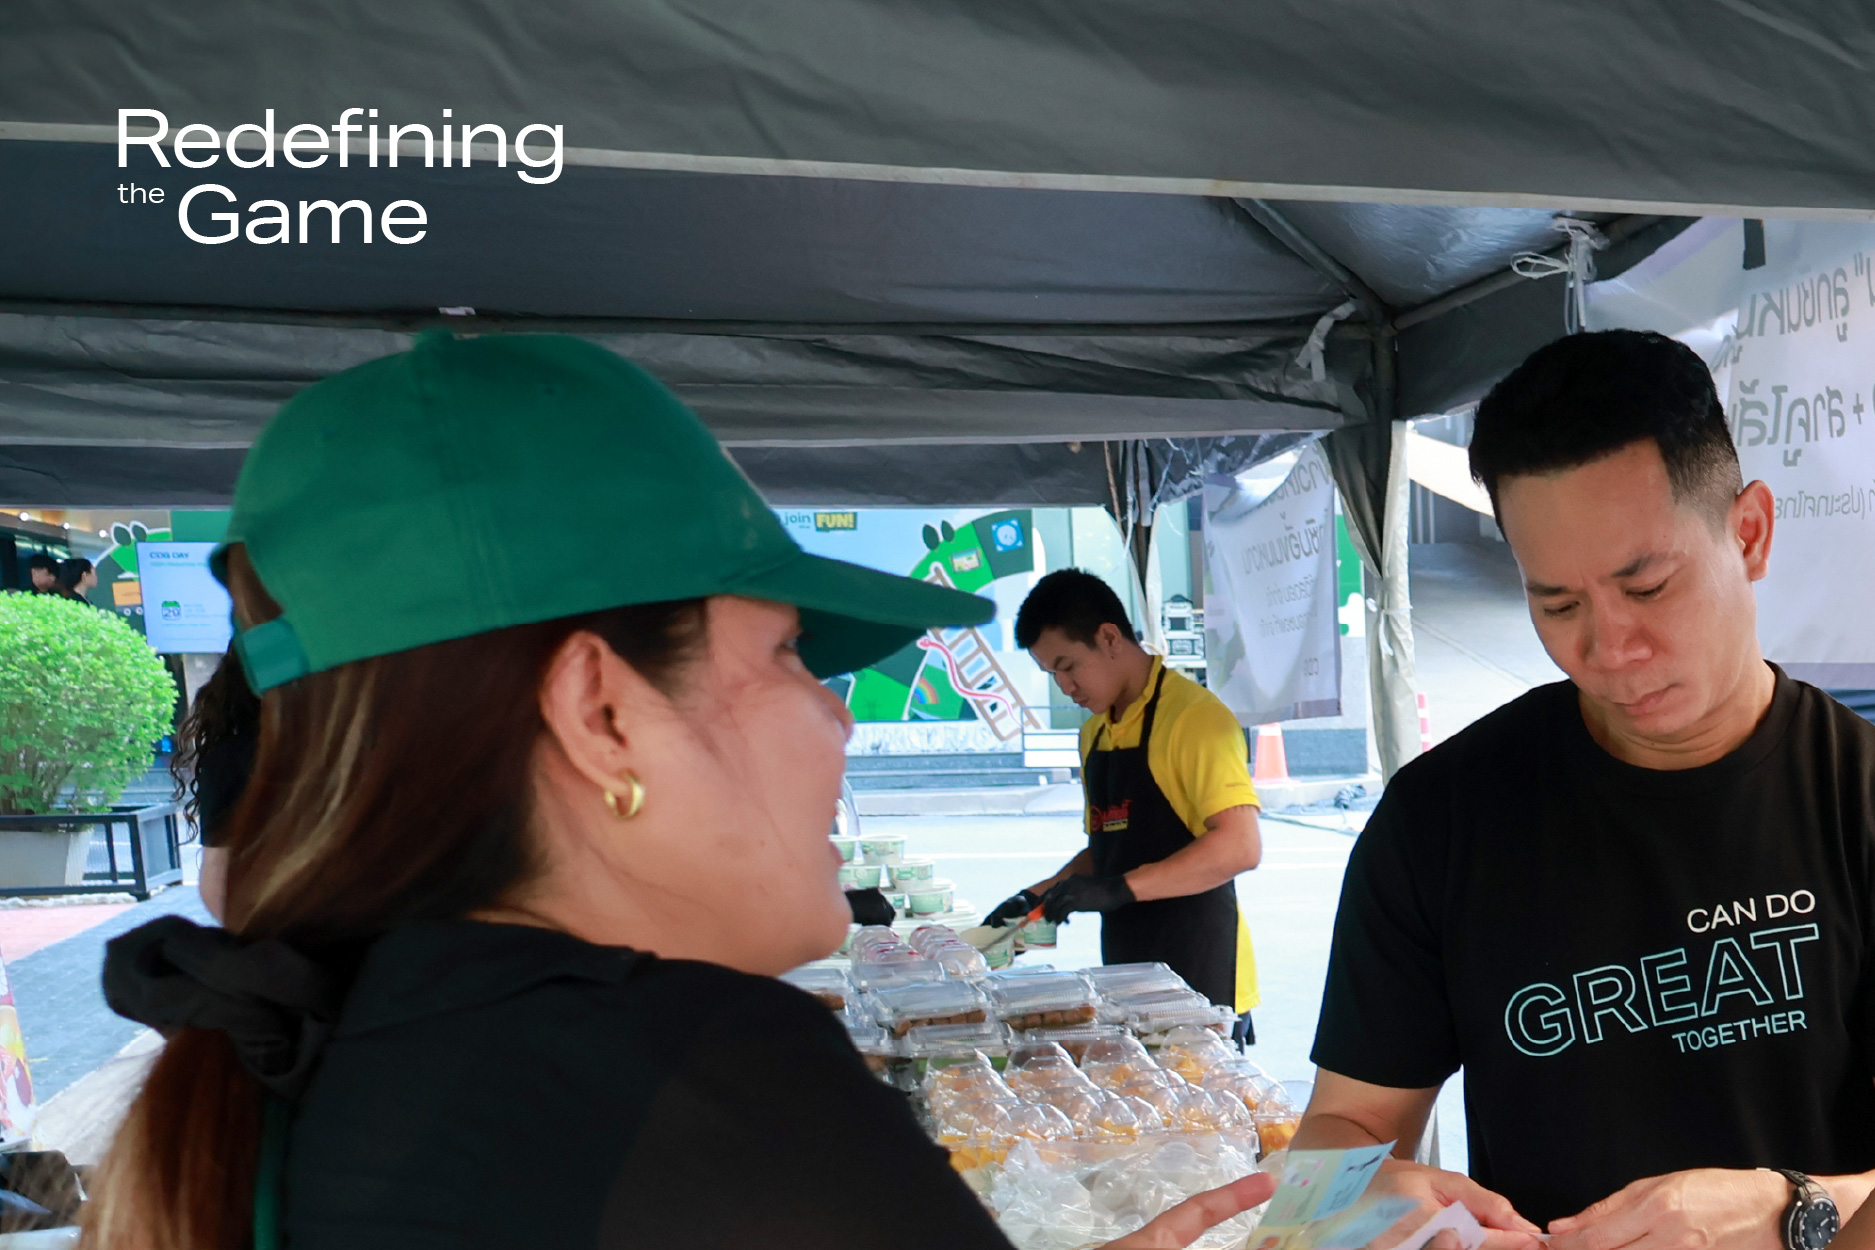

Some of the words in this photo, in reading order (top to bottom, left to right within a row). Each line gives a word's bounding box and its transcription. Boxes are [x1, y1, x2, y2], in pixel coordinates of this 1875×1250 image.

[815, 512, 855, 528] FUN!
[1686, 896, 1757, 933] CAN
[1765, 889, 1816, 919] DO
[1504, 923, 1820, 1057] GREAT
[1672, 1010, 1807, 1053] TOGETHER
